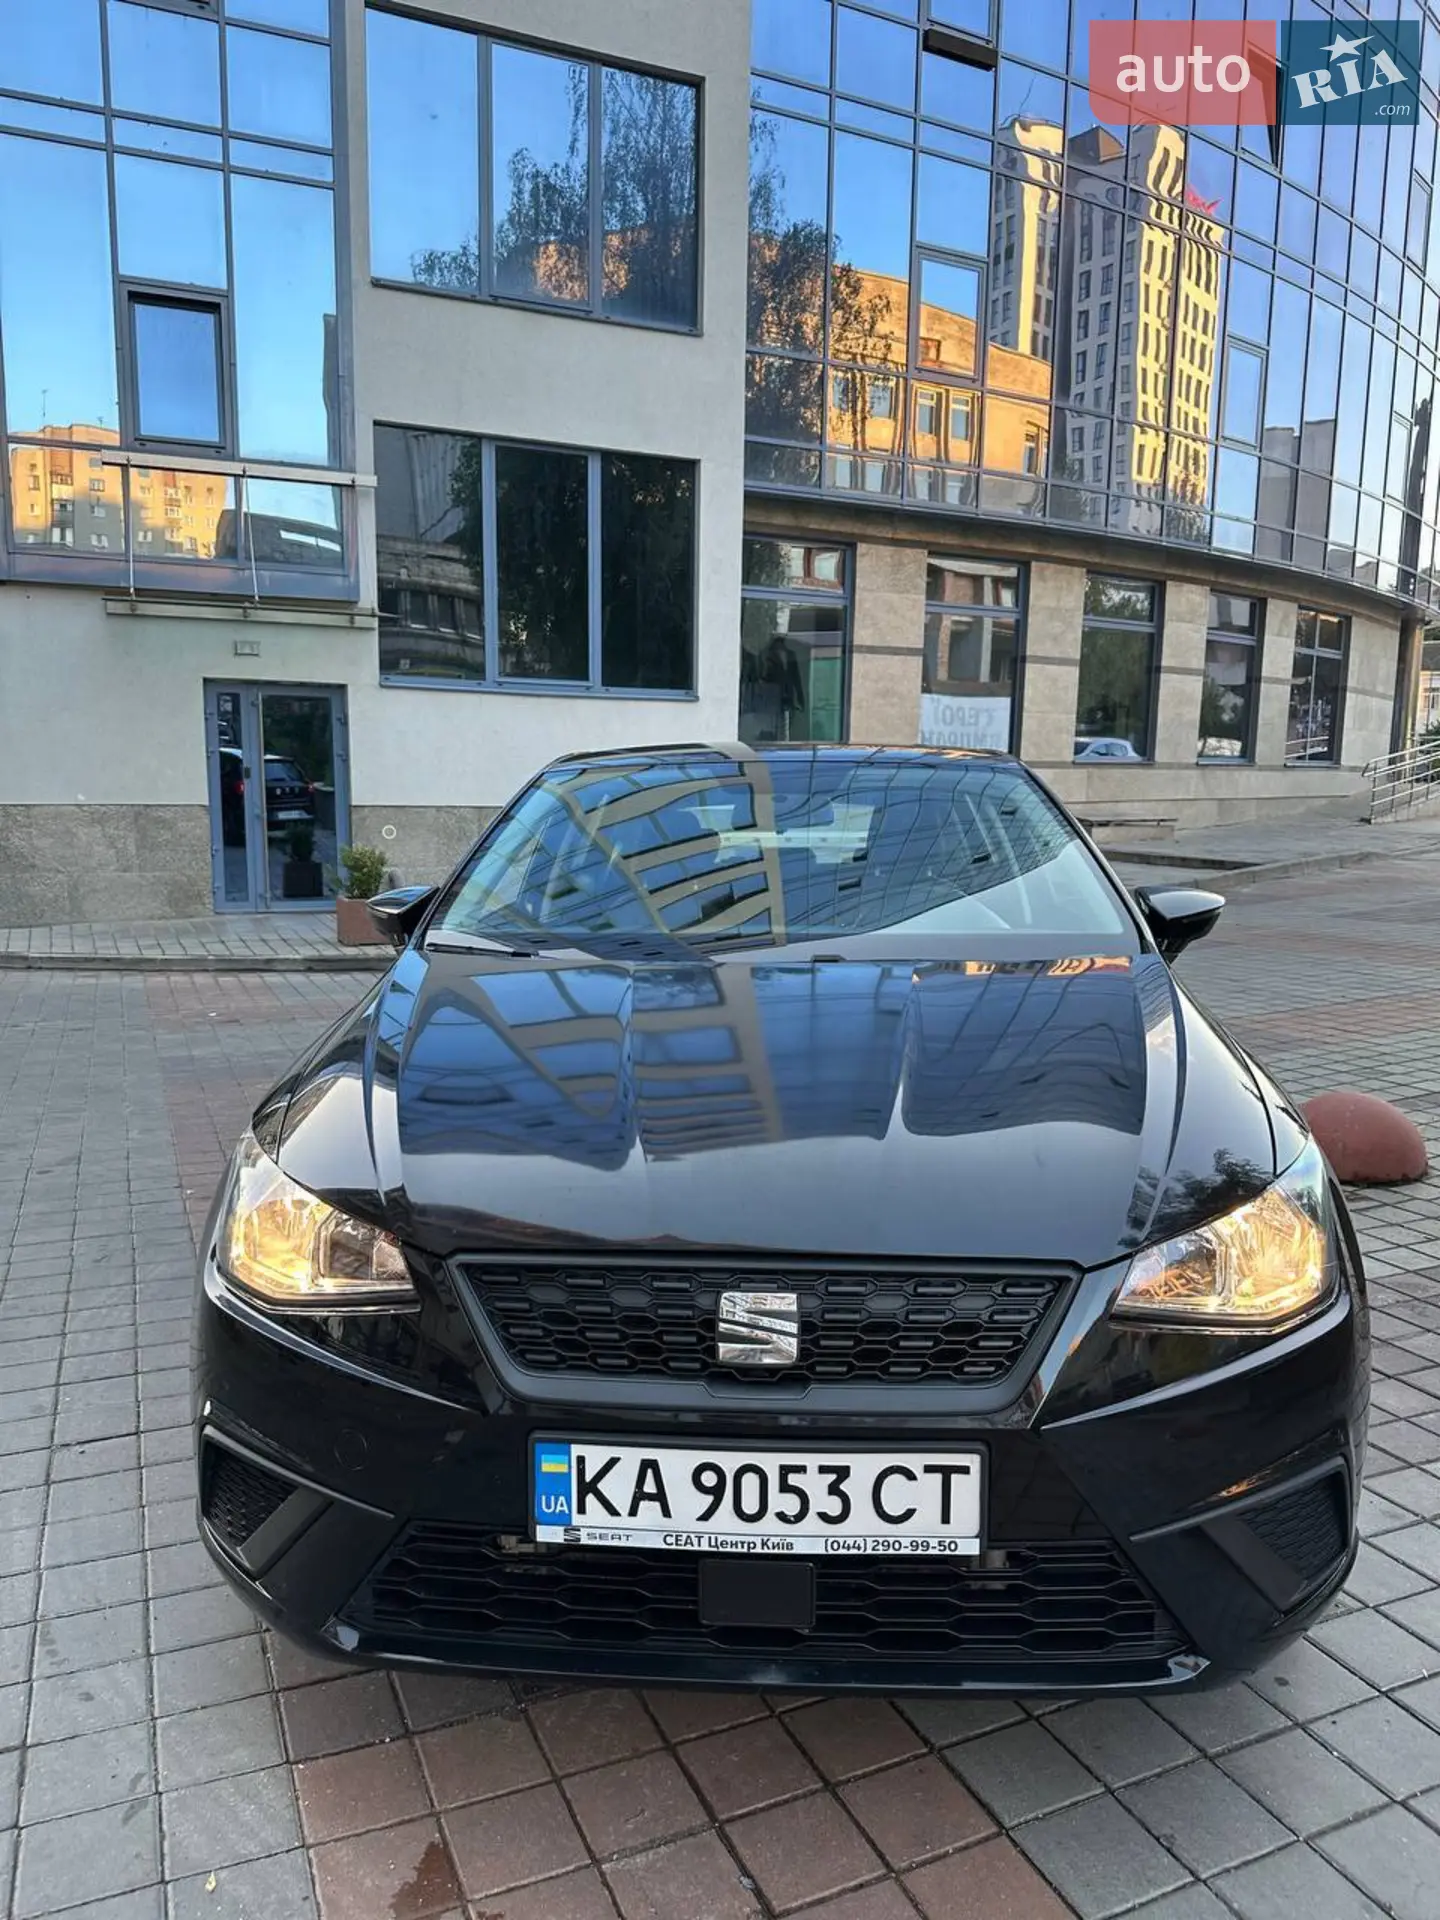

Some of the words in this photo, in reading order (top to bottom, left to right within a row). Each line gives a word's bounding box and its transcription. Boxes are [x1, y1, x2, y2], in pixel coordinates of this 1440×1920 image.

[576, 1455, 672, 1519] KA
[691, 1462, 852, 1525] 9053
[872, 1464, 972, 1525] CT
[541, 1495, 569, 1514] UA
[586, 1532, 633, 1542] SEAT
[662, 1533, 704, 1548] СЕАТ
[708, 1536, 757, 1551] Центр
[760, 1538, 794, 1551] Київ
[824, 1539, 868, 1553] (044)
[872, 1540, 959, 1552] 290-99-50
